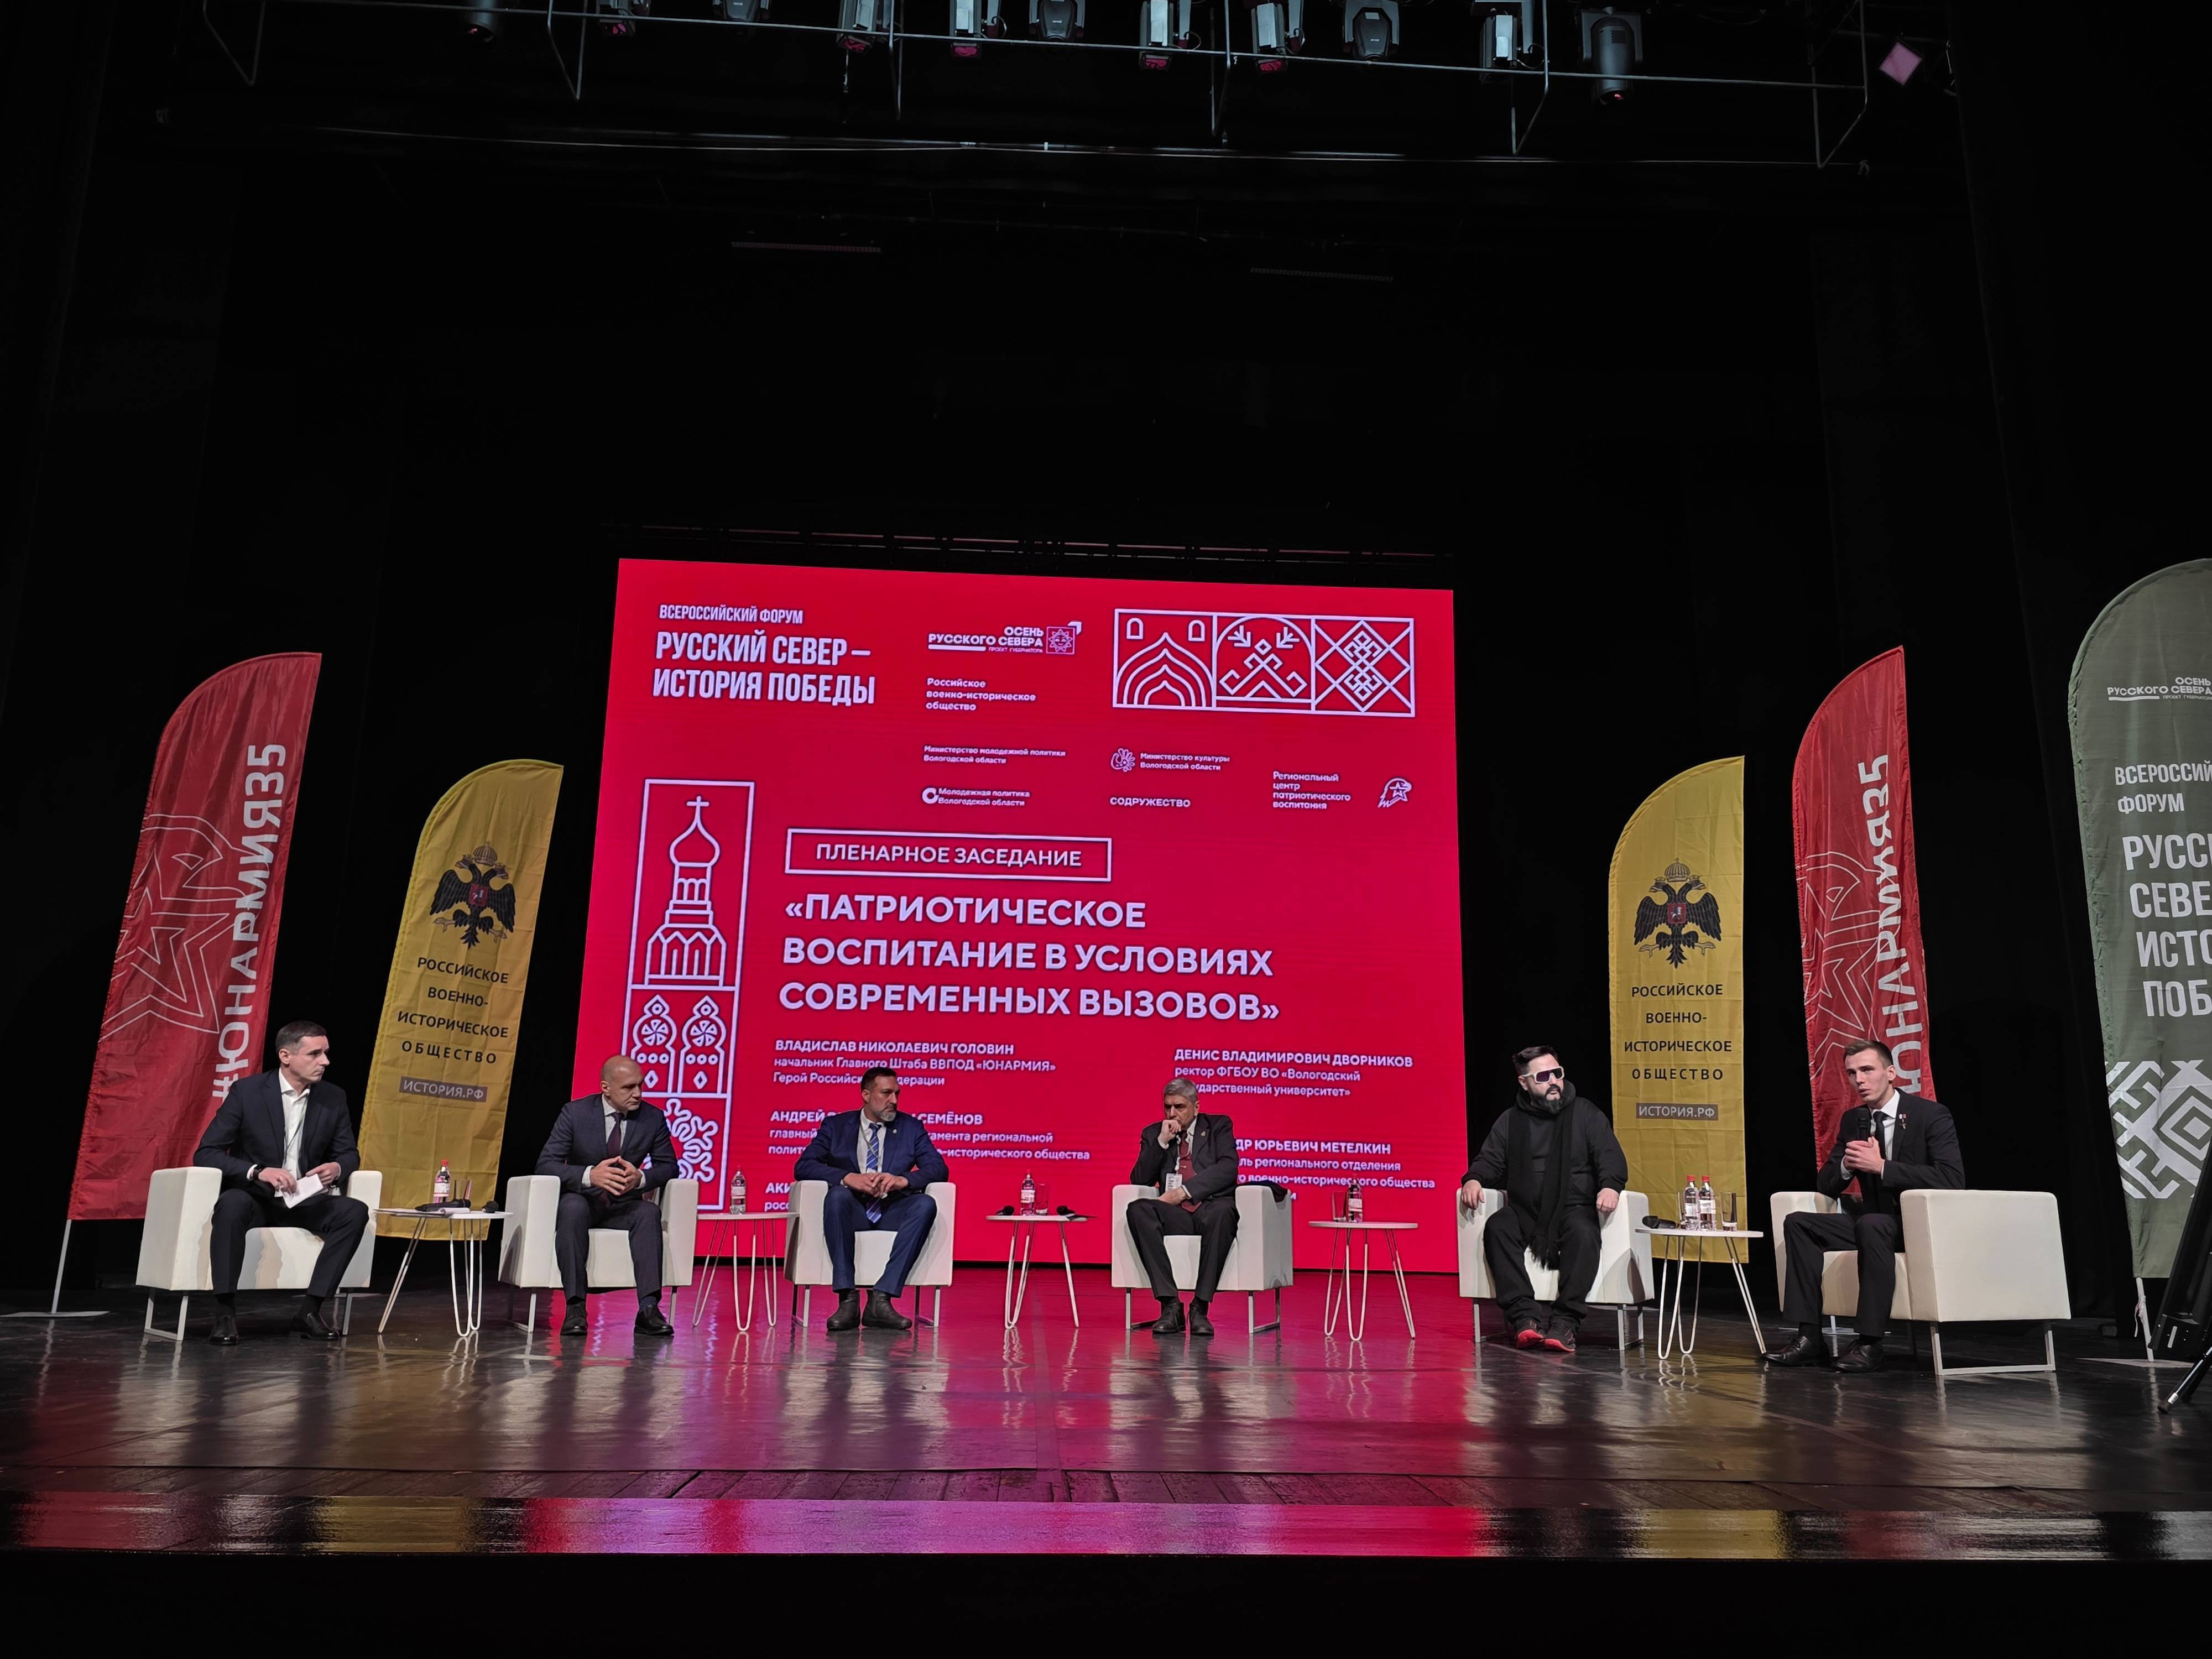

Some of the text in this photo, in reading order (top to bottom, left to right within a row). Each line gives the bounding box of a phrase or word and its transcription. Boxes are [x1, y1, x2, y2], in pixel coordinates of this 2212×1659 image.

[660, 604, 802, 623] ВСЕРОССИЙСКИЙ ФОРУМ
[1004, 627, 1044, 637] ОСЕНЬ
[928, 633, 1044, 647] РУССКОГО СЕВЕРА
[656, 630, 766, 662] РУССКИЙ
[773, 636, 847, 665] СЕВЕР
[653, 669, 875, 706] ИСТОРИЯ ПОБЕДЫ
[927, 678, 985, 687] Российское
[2175, 677, 2211, 686] ОСЕНЬ
[927, 691, 1036, 701] военно-историческое
[2107, 686, 2212, 695] РУССКОГО СЕВЕРА
[926, 702, 976, 710] общество
[1274, 771, 1338, 781] Региональный
[938, 788, 991, 796] Молодежная
[1273, 792, 1350, 801] патриотического
[938, 797, 990, 806] Вологодской
[1110, 797, 1190, 807] СОДРУЖЕСТВО
[2117, 793, 2185, 814] ФОРУМ
[817, 844, 1081, 867] ПЛЕНАРНОЕ ЗАСЕДАНИЕ
[2122, 833, 2212, 870] РУСС
[786, 894, 1145, 927] «ПАТРИОТИЧЕСКОЕ
[784, 938, 1272, 975] ВОСПИТАНИЕ В УСЛОВИЯХ
[418, 957, 509, 983] РОССИЙСКОЕ
[428, 987, 489, 1006] ВОЕННО-
[1632, 983, 1723, 997] РОССИЙСКОЕ
[780, 983, 1279, 1020] СОВРЕМЕННЫХ ВЫЗОВОВ»
[398, 1011, 508, 1037] ИСТОРИЧЕСКОЕ
[1646, 1013, 1707, 1023] ВОЕННО-
[402, 1041, 496, 1063] ОБЩЕСТВО
[776, 1040, 1014, 1054] ВЛАДИСЛАВ НИКОЛАЕВИЧ ГОЛОВИН
[1625, 1041, 1731, 1052] ИСТОРИЧЕСКОЕ
[837, 1057, 887, 1068] Главного
[890, 1058, 927, 1068] Штаба
[930, 1059, 974, 1071] ВВПОД
[977, 1060, 1055, 1071] «ЮНАРМИЯ»
[1175, 1049, 1412, 1067] ДЕНИС ВЛАДИМИРОВИЧ ДВОРНИКОВ
[774, 1072, 807, 1084] Герой
[1175, 1067, 1360, 1081] ректор ФГБОУ ВО «Вологодский
[1632, 1069, 1723, 1081] ОБЩЕСТВО
[403, 1079, 484, 1101] ИСТОРИЯ.РФ
[1274, 1087, 1350, 1097] университет»
[771, 1109, 825, 1123] АНДРЕЙ
[1639, 1104, 1715, 1119] ИСТОРИЯ.РФ
[770, 1129, 817, 1138] главный
[973, 1133, 1053, 1142] региональной
[1035, 1149, 1089, 1159] общества
[1255, 1140, 1318, 1151] ЮРЬЕВИЧ
[1321, 1142, 1390, 1154] МЕТЕЛКИН
[1255, 1159, 1339, 1168] регионального
[1342, 1161, 1400, 1170] отделения
[1380, 1177, 1435, 1188] общества
